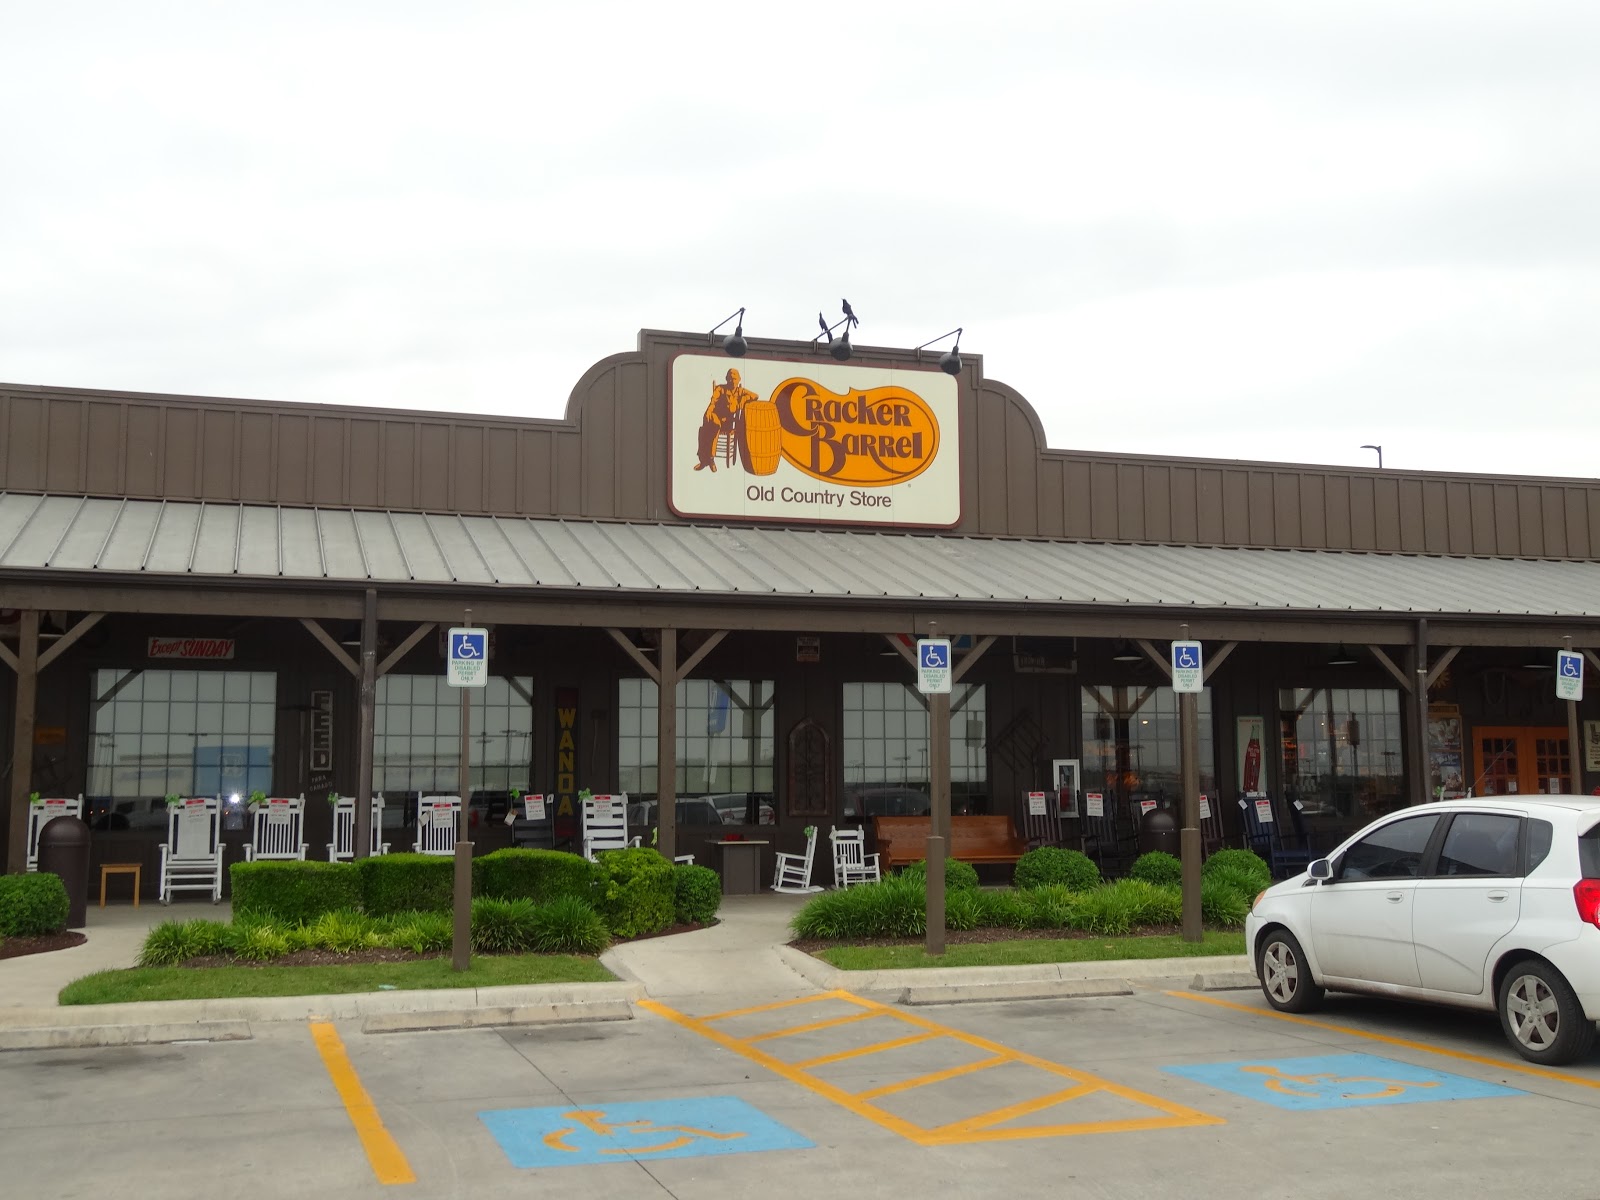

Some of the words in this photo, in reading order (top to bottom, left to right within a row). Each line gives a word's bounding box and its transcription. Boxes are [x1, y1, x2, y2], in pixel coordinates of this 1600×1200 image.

[777, 381, 912, 437] Cracker
[809, 421, 923, 477] Barrel
[746, 485, 775, 502] Old
[780, 487, 845, 508] Country
[849, 490, 892, 508] Store
[149, 639, 183, 656] Except
[180, 639, 234, 657] SUNDAY
[557, 707, 577, 817] WANDA
